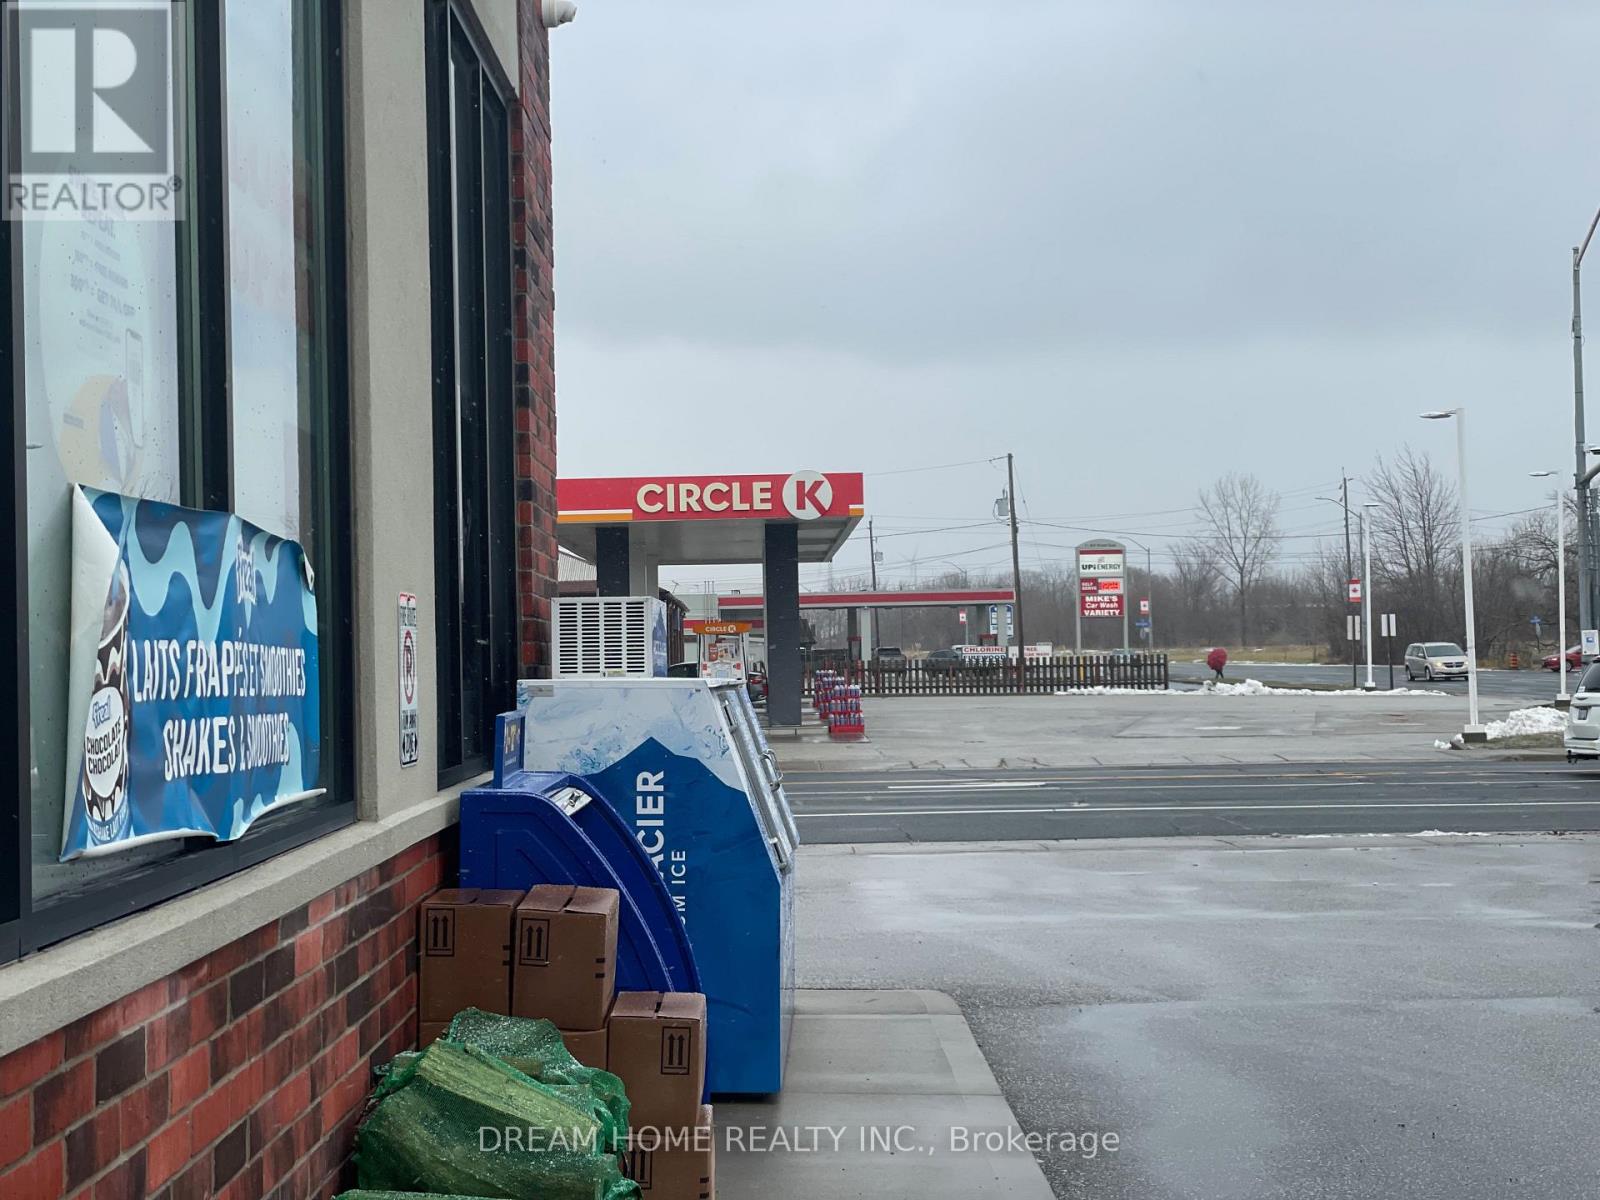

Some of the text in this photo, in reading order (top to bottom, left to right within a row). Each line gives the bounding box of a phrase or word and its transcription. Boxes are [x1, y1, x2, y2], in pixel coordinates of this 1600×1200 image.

[637, 479, 831, 518] CIRCLE K
[132, 627, 306, 702] LAITS FRAPPÉS ET SMOOTHIES
[86, 717, 121, 755] CHOCOLATE
[163, 714, 236, 781] SHAKES
[247, 712, 290, 770] SMOOTHIES
[671, 850, 686, 885] ICE
